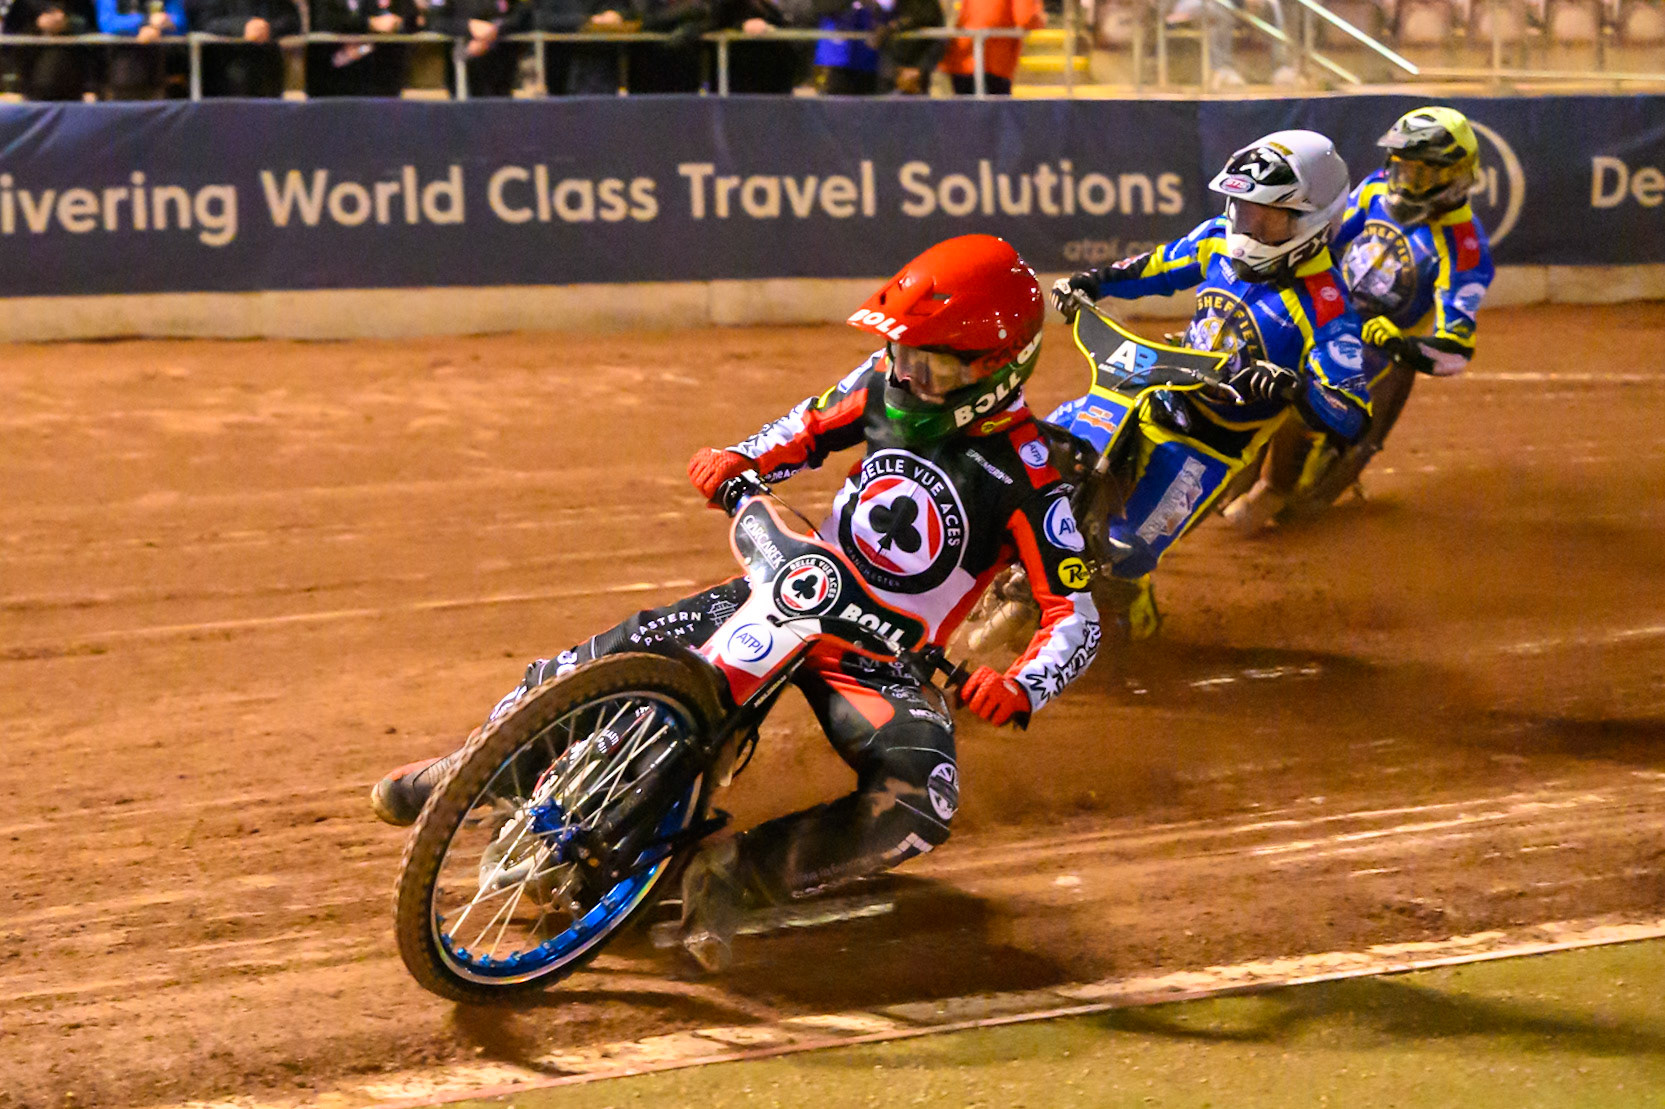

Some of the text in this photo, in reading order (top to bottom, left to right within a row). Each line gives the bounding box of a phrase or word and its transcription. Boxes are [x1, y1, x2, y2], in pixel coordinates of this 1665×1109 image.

[260, 164, 465, 226] World
[488, 164, 659, 223] Class
[677, 160, 876, 219] Travel
[899, 159, 1184, 217] Solutions
[1591, 156, 1665, 208] De
[848, 309, 908, 341] BOLL
[954, 373, 1021, 427] BOLL
[861, 459, 961, 547] BELLE VUE ACES
[818, 560, 834, 576] VUE
[827, 577, 838, 599] ACES
[630, 611, 702, 644] EASTERN
[736, 632, 764, 654] ATPI
